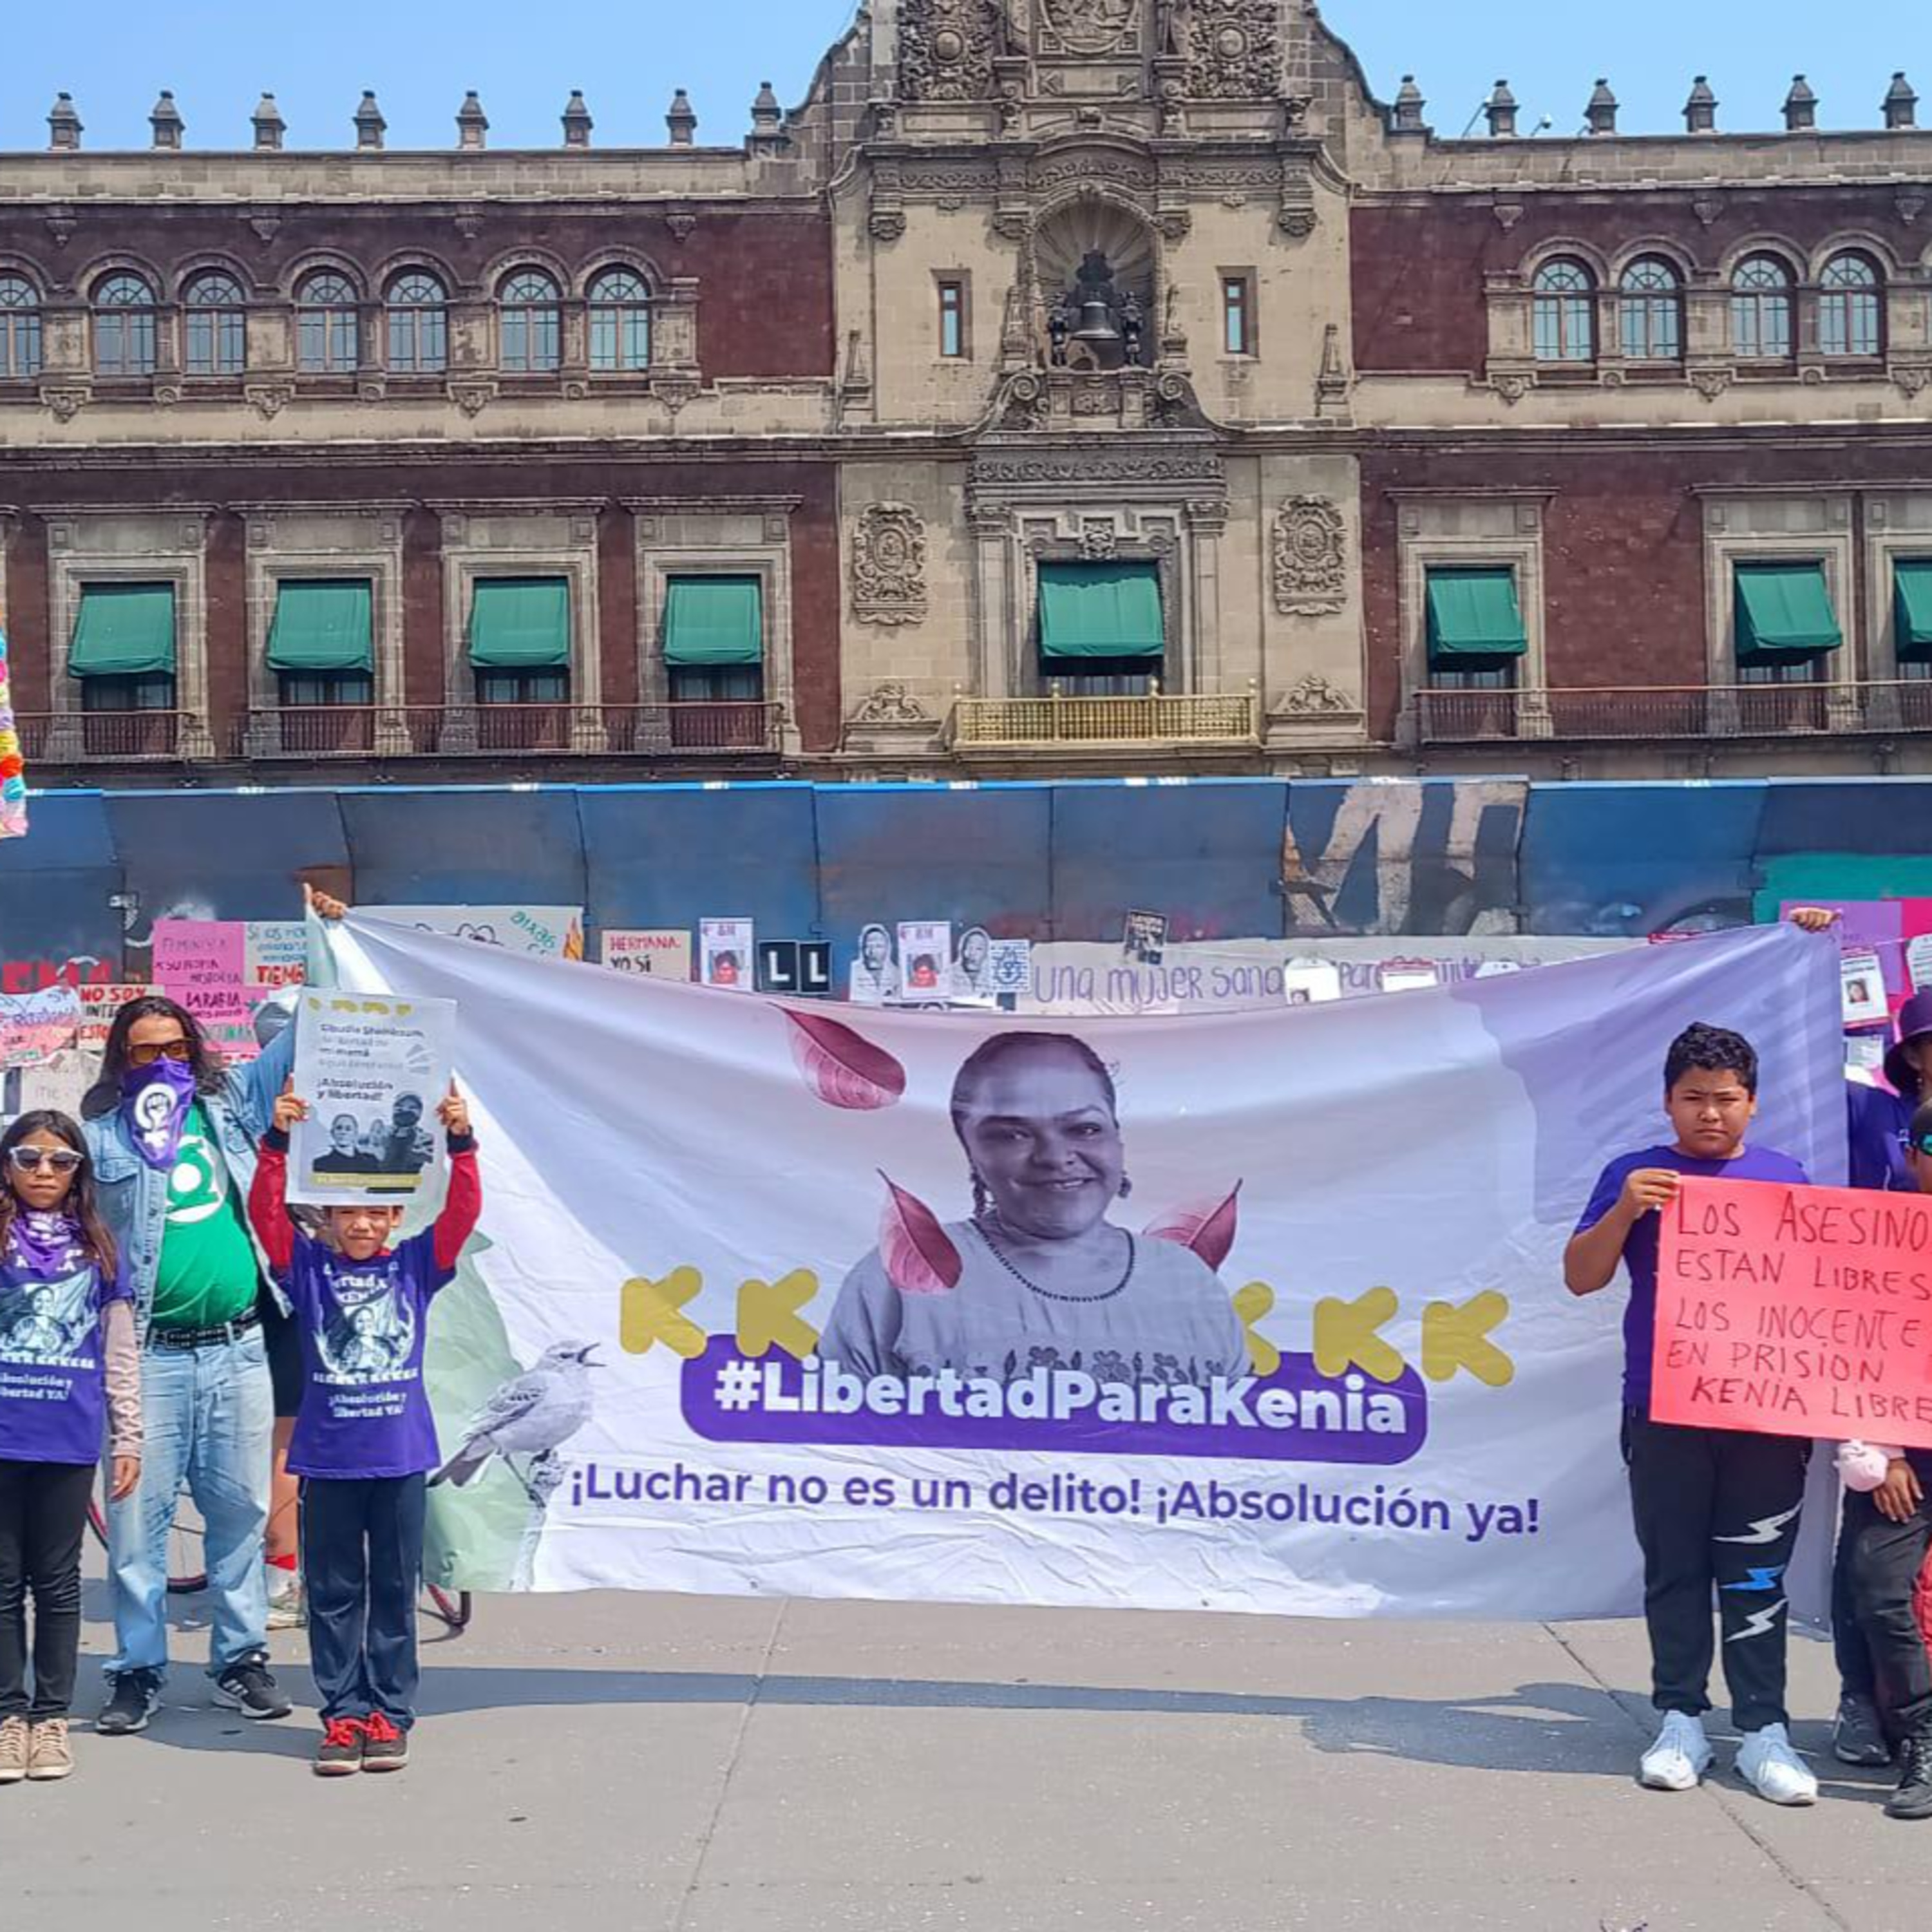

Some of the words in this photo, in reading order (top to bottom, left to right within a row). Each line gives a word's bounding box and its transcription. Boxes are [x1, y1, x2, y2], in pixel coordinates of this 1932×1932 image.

[770, 951, 790, 981] L
[810, 951, 827, 982] L
[1035, 966, 1094, 1003] Una
[1212, 966, 1283, 998] sana
[80, 987, 104, 1001] NO
[109, 987, 146, 1001] SOY
[1678, 1184, 1741, 1236] LOS
[1676, 1249, 1785, 1283] ESTAN
[1814, 1256, 1931, 1301] LIBRES
[1675, 1297, 1730, 1331] LOS
[1757, 1304, 1921, 1350] INOCENTE
[1665, 1340, 1709, 1369] EN
[714, 1354, 1406, 1434] #LibertadParaKenia
[573, 1463, 752, 1506] ¡Luchar
[769, 1475, 828, 1504] no
[844, 1477, 895, 1506] es
[913, 1479, 971, 1508] un
[989, 1473, 1141, 1515] delito!
[1157, 1480, 1449, 1530] ¡Absolución
[1466, 1499, 1539, 1541] ya!
